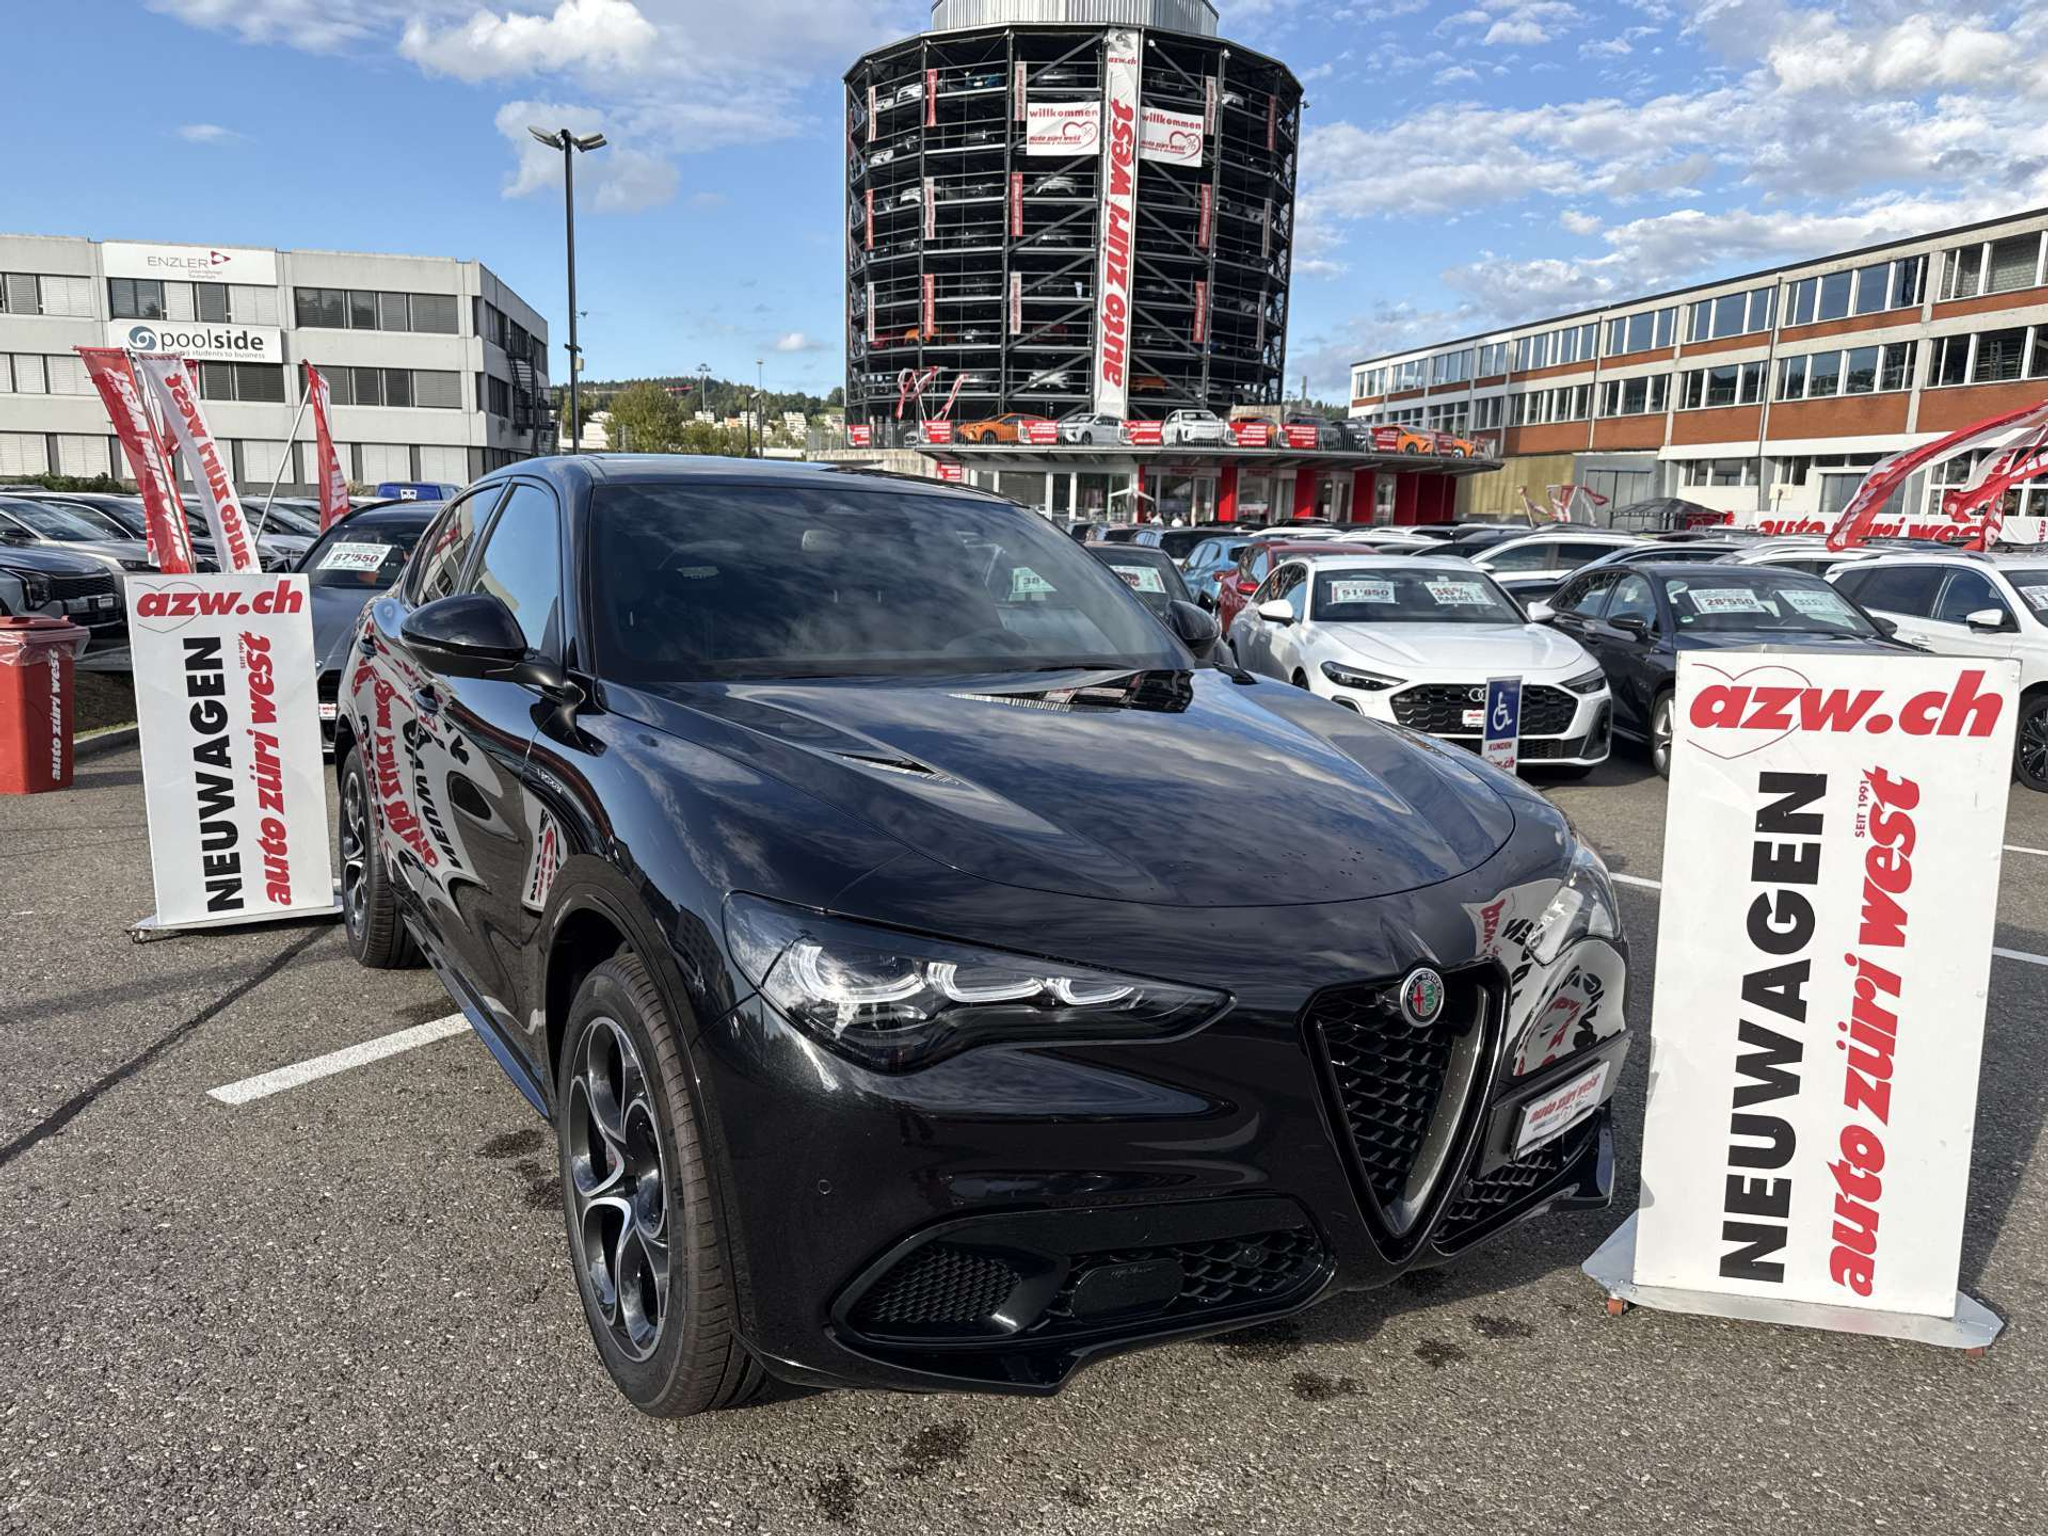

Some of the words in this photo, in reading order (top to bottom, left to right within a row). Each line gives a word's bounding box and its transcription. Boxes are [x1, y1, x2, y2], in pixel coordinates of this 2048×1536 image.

[1029, 108, 1098, 117] willkommen
[1110, 98, 1134, 196] west
[1142, 112, 1201, 129] willkommen
[147, 256, 209, 269] ENZLER
[160, 328, 264, 351] poolside
[1101, 293, 1127, 387] auto
[136, 580, 303, 617] azw.ch
[49, 649, 61, 693] west
[239, 631, 277, 724] west
[1690, 670, 2004, 738] azw.ch
[52, 736, 61, 780] auto
[183, 637, 244, 912] NEUWAGEN
[246, 729, 285, 815] züri
[1858, 780, 1870, 808] 1991
[257, 817, 292, 905] auto
[1855, 813, 1866, 838] SEIT
[1858, 766, 1920, 948] west
[1719, 771, 1829, 1284] NEUWAGEN
[1836, 953, 1902, 1127] züri
[1826, 1125, 1889, 1298] auto
